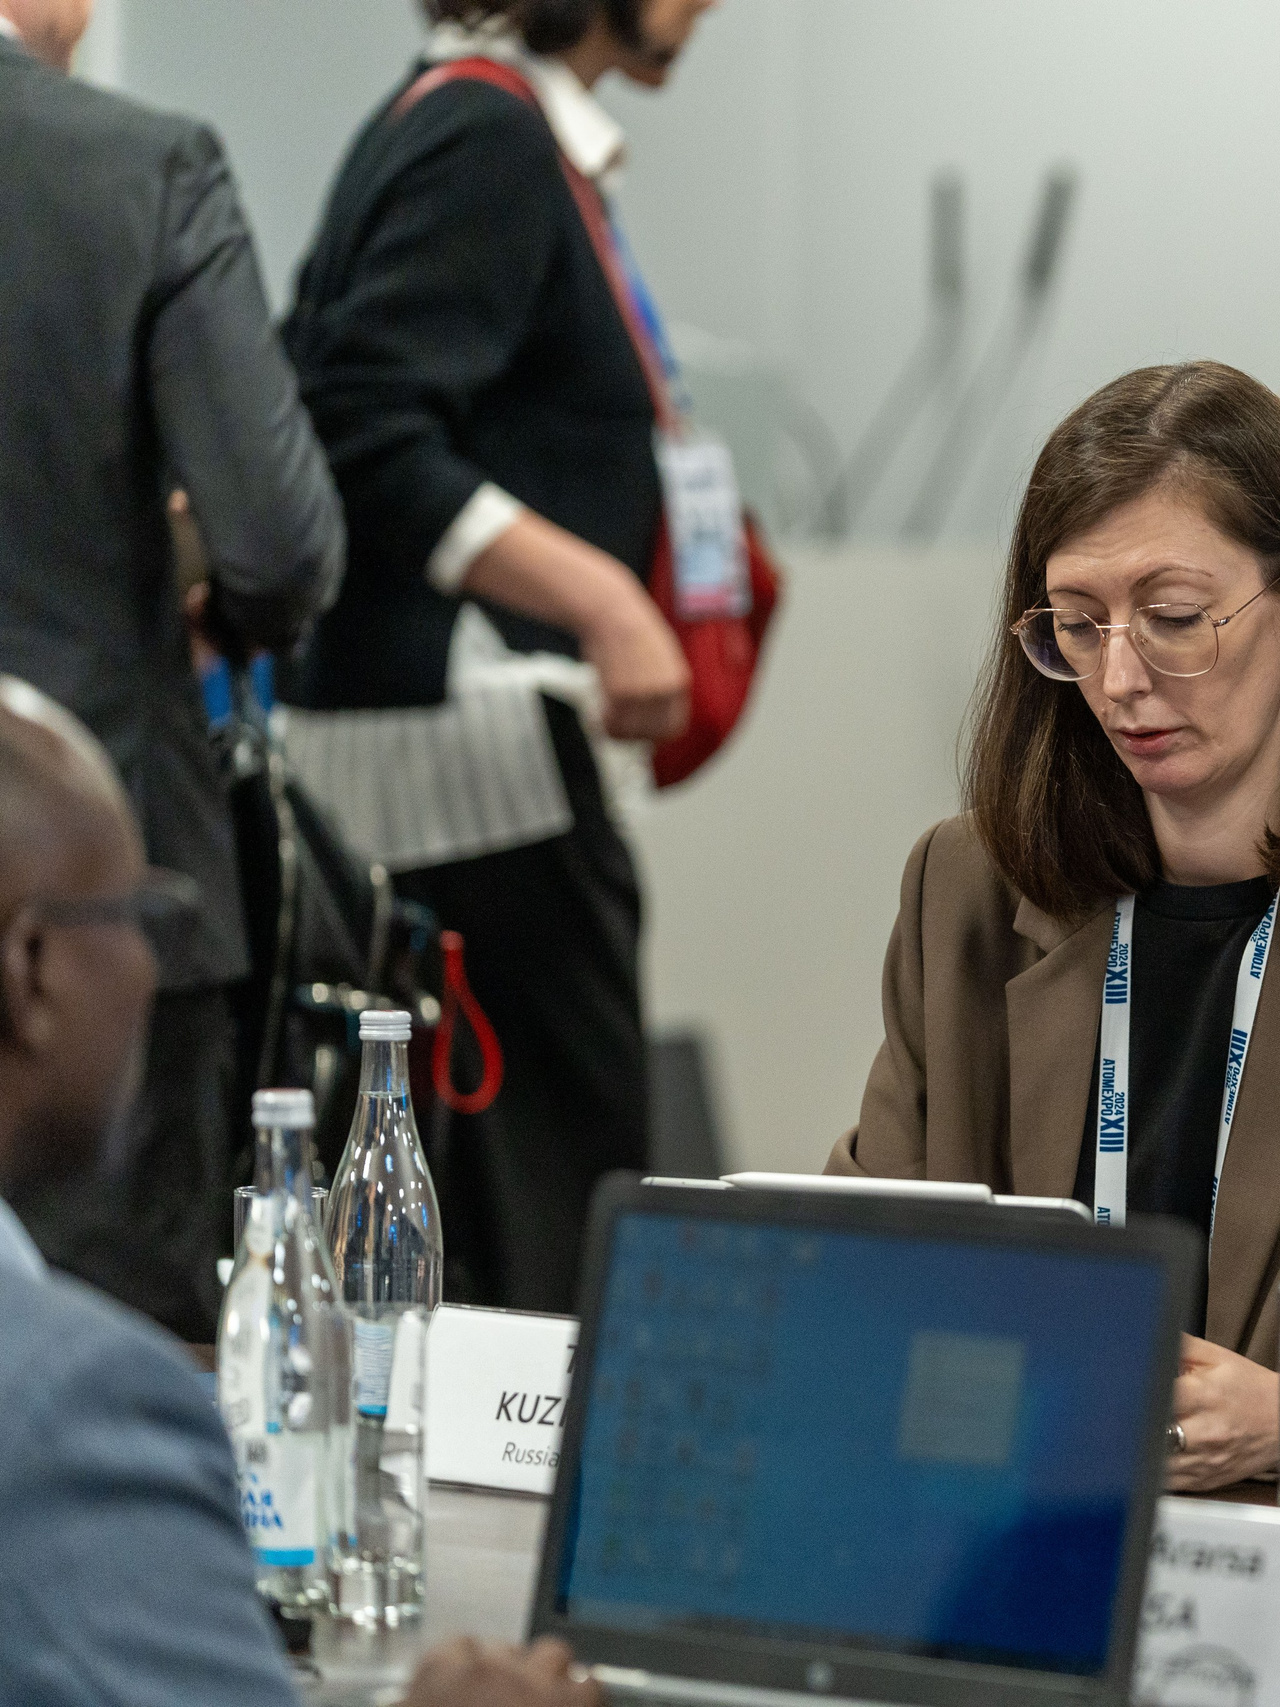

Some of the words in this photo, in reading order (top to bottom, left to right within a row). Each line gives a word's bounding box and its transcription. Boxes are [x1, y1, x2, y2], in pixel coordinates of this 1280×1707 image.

[1118, 943, 1129, 968] 2024
[1250, 921, 1272, 979] ATOMEXPO
[1105, 967, 1128, 1004] XIII
[1229, 1028, 1248, 1068] XIII
[1100, 1058, 1116, 1116] ATOMEXPO
[1114, 1091, 1125, 1116] 2024
[1224, 1066, 1241, 1125] ATOMEXPO
[1099, 1116, 1125, 1153] XIII
[496, 1391, 564, 1427] KUZ
